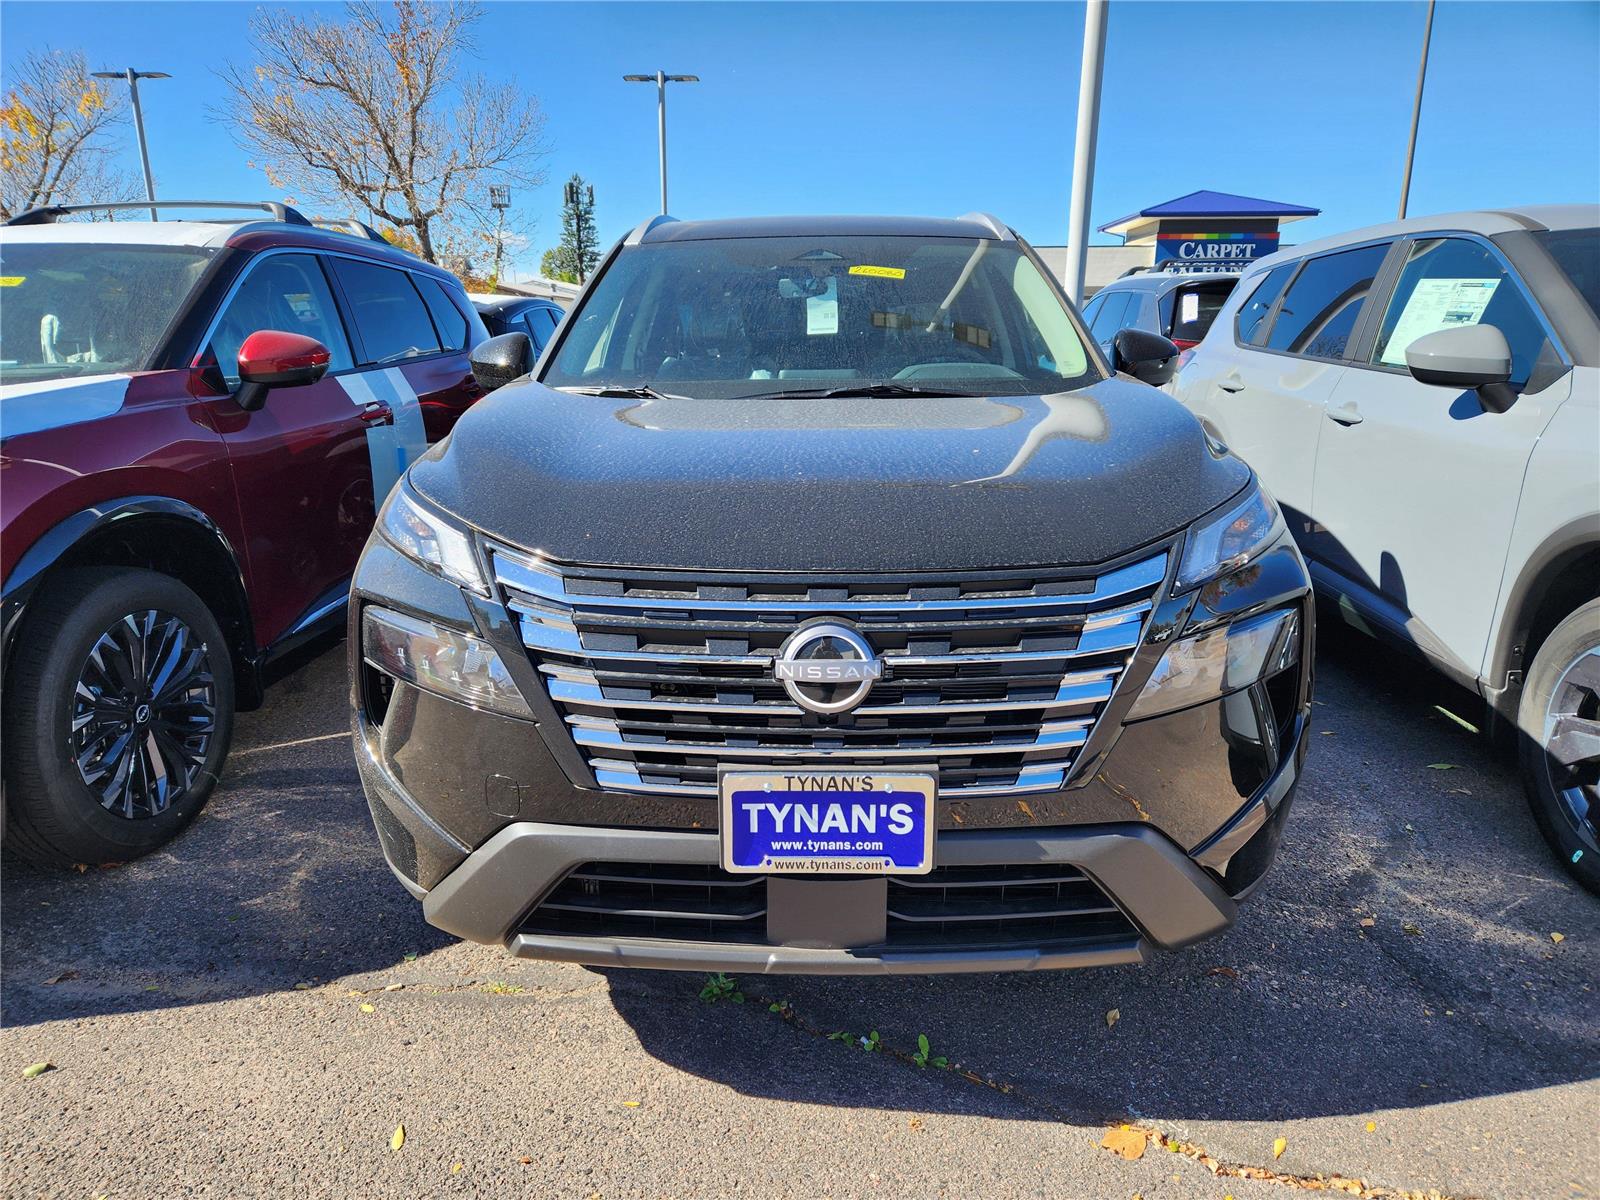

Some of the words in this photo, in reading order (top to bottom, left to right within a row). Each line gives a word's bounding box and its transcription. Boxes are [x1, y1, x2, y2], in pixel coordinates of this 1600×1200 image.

[1179, 241, 1256, 259] CARPET
[779, 664, 879, 679] NISSAN
[784, 775, 874, 792] TYNAN'S
[741, 803, 914, 835] TYNAN'S
[771, 839, 884, 853] www.tynans.com
[774, 858, 883, 873] www.tynans.com
